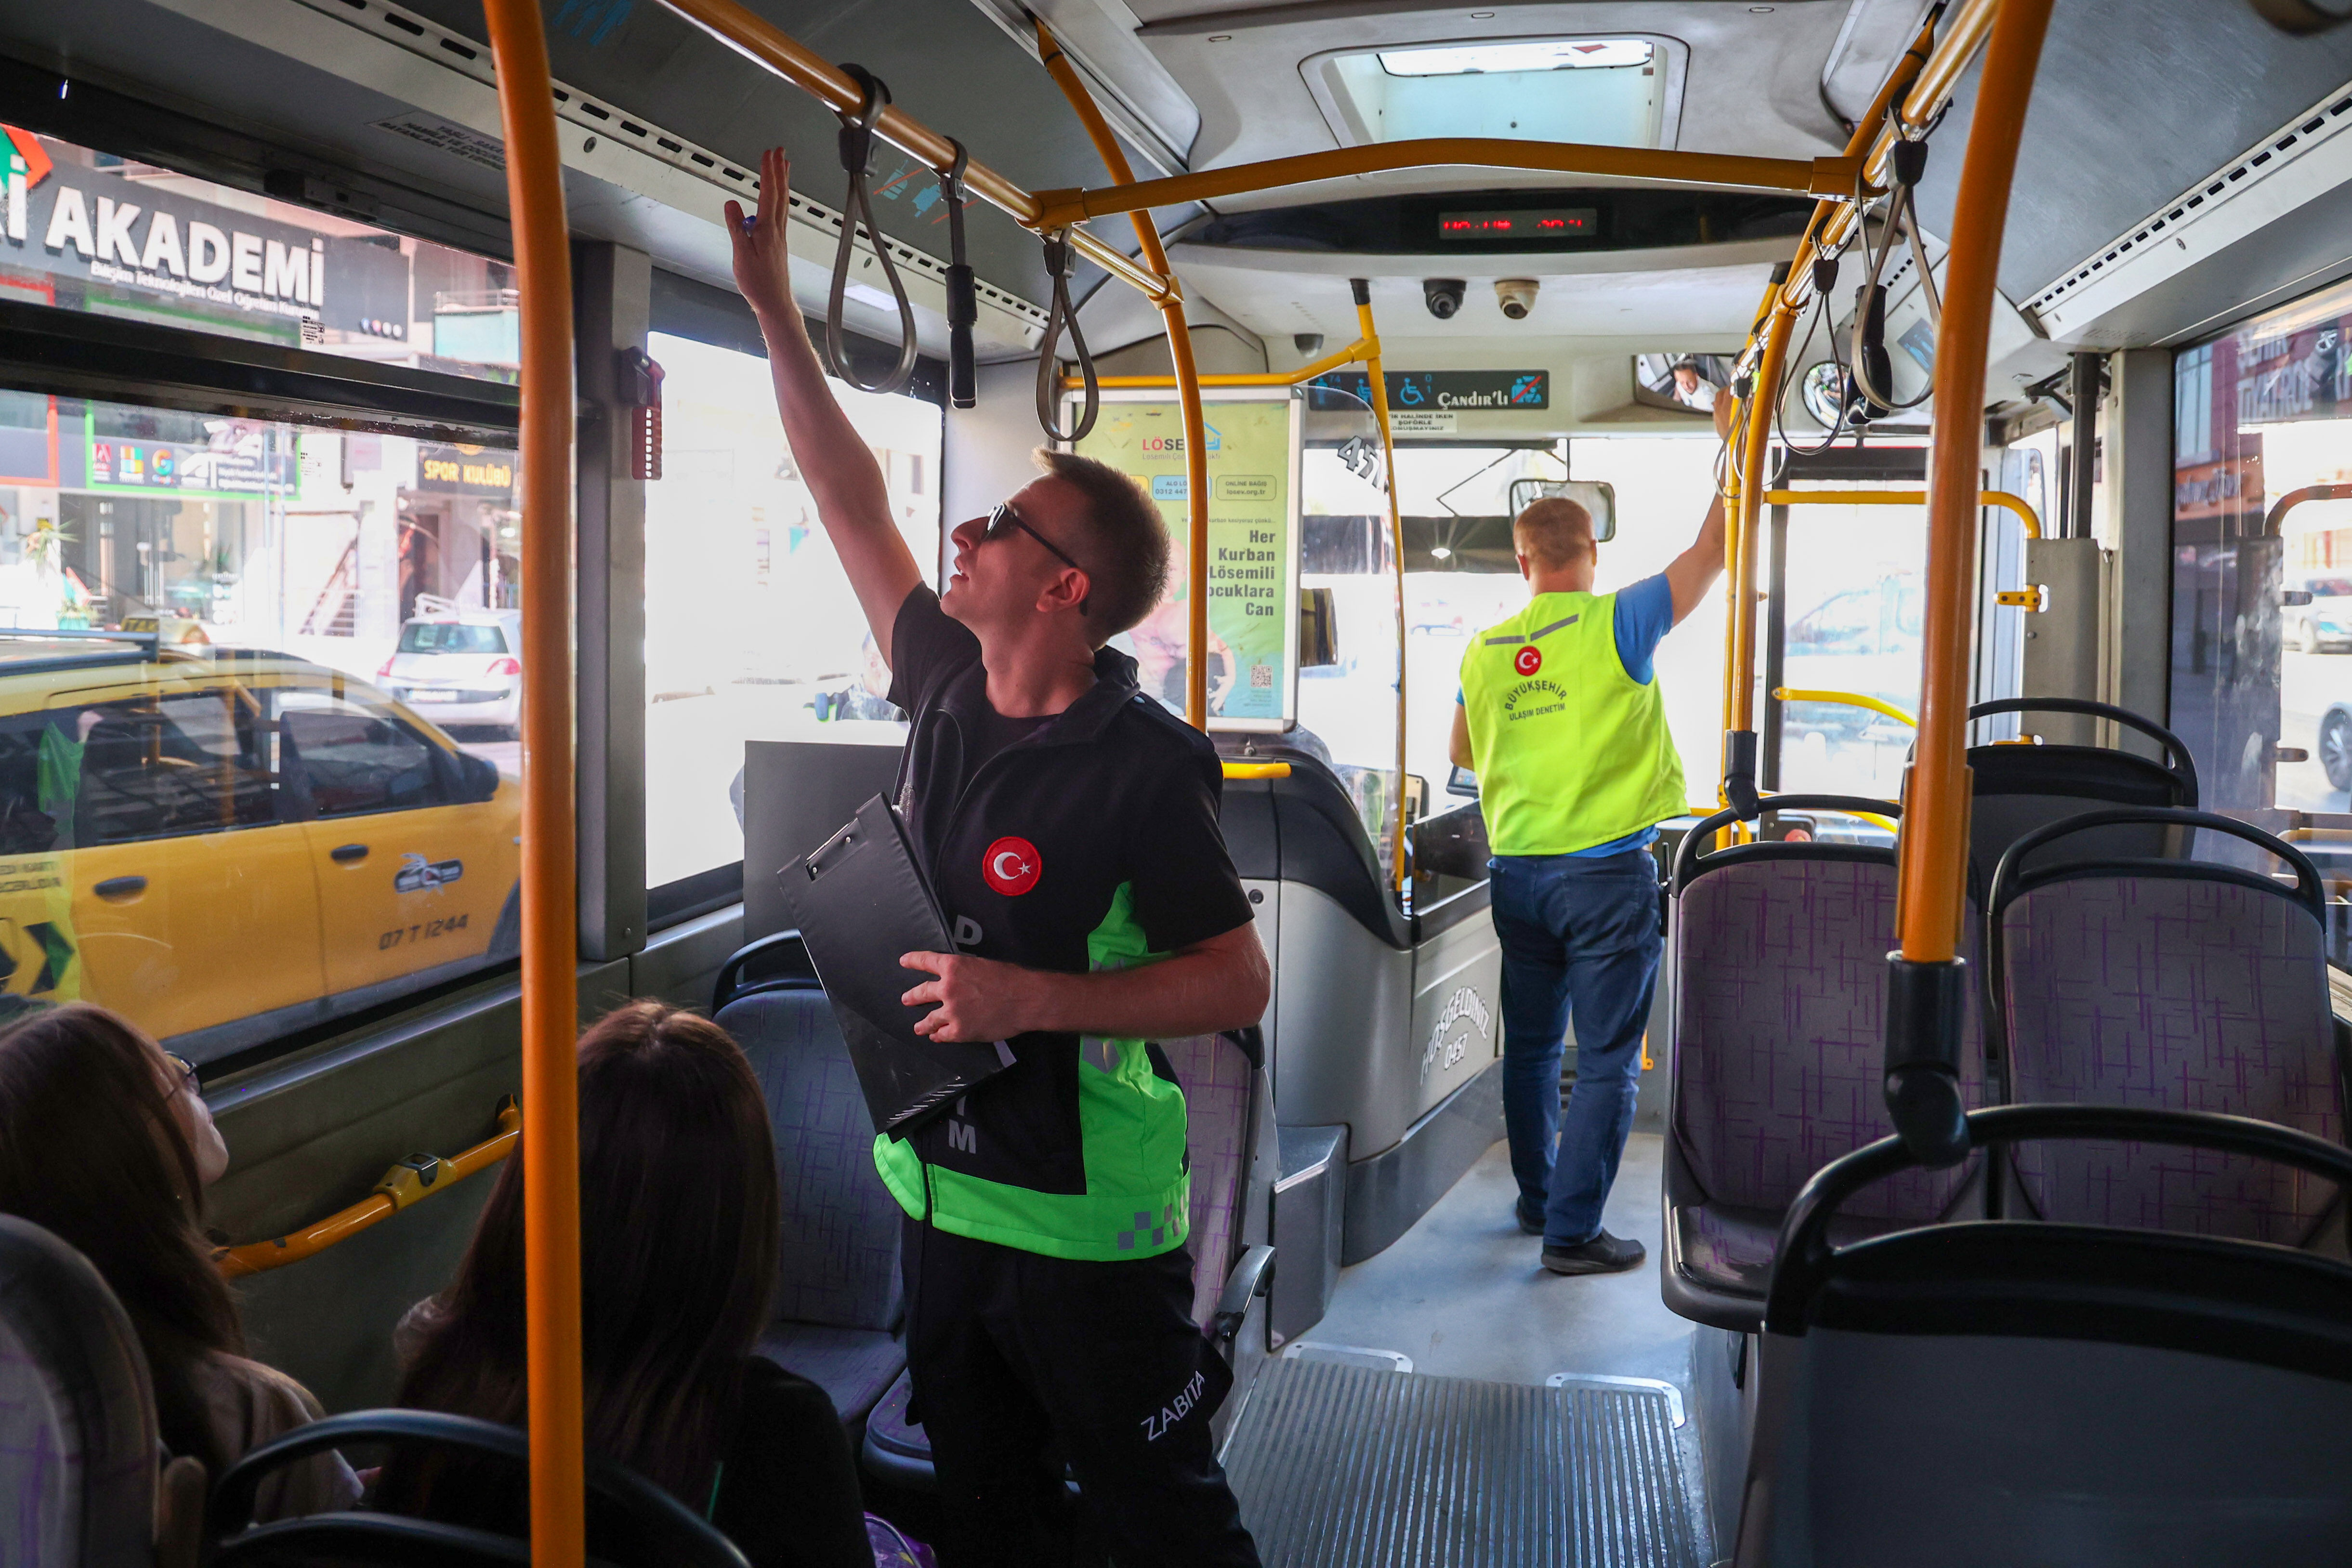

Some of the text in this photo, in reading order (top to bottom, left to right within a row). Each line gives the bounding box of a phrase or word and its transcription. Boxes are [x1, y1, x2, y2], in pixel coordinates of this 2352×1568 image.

[45, 185, 324, 306] AKADEMİ
[1143, 436, 1184, 451] LÖSE
[424, 460, 512, 488] SPOR KULÜBÜ
[1249, 530, 1275, 543] Her
[1219, 547, 1275, 561] Kurban
[1209, 565, 1275, 579] Lösemili
[1209, 584, 1275, 598] ocuklara
[1245, 602, 1274, 616] Can
[1505, 680, 1567, 711] BÜYÜKŞEHİR
[1509, 702, 1566, 721] ULAŞIM DENETİM
[378, 927, 404, 951] 07
[408, 924, 421, 945] T
[1140, 1370, 1205, 1441] ZABITA
